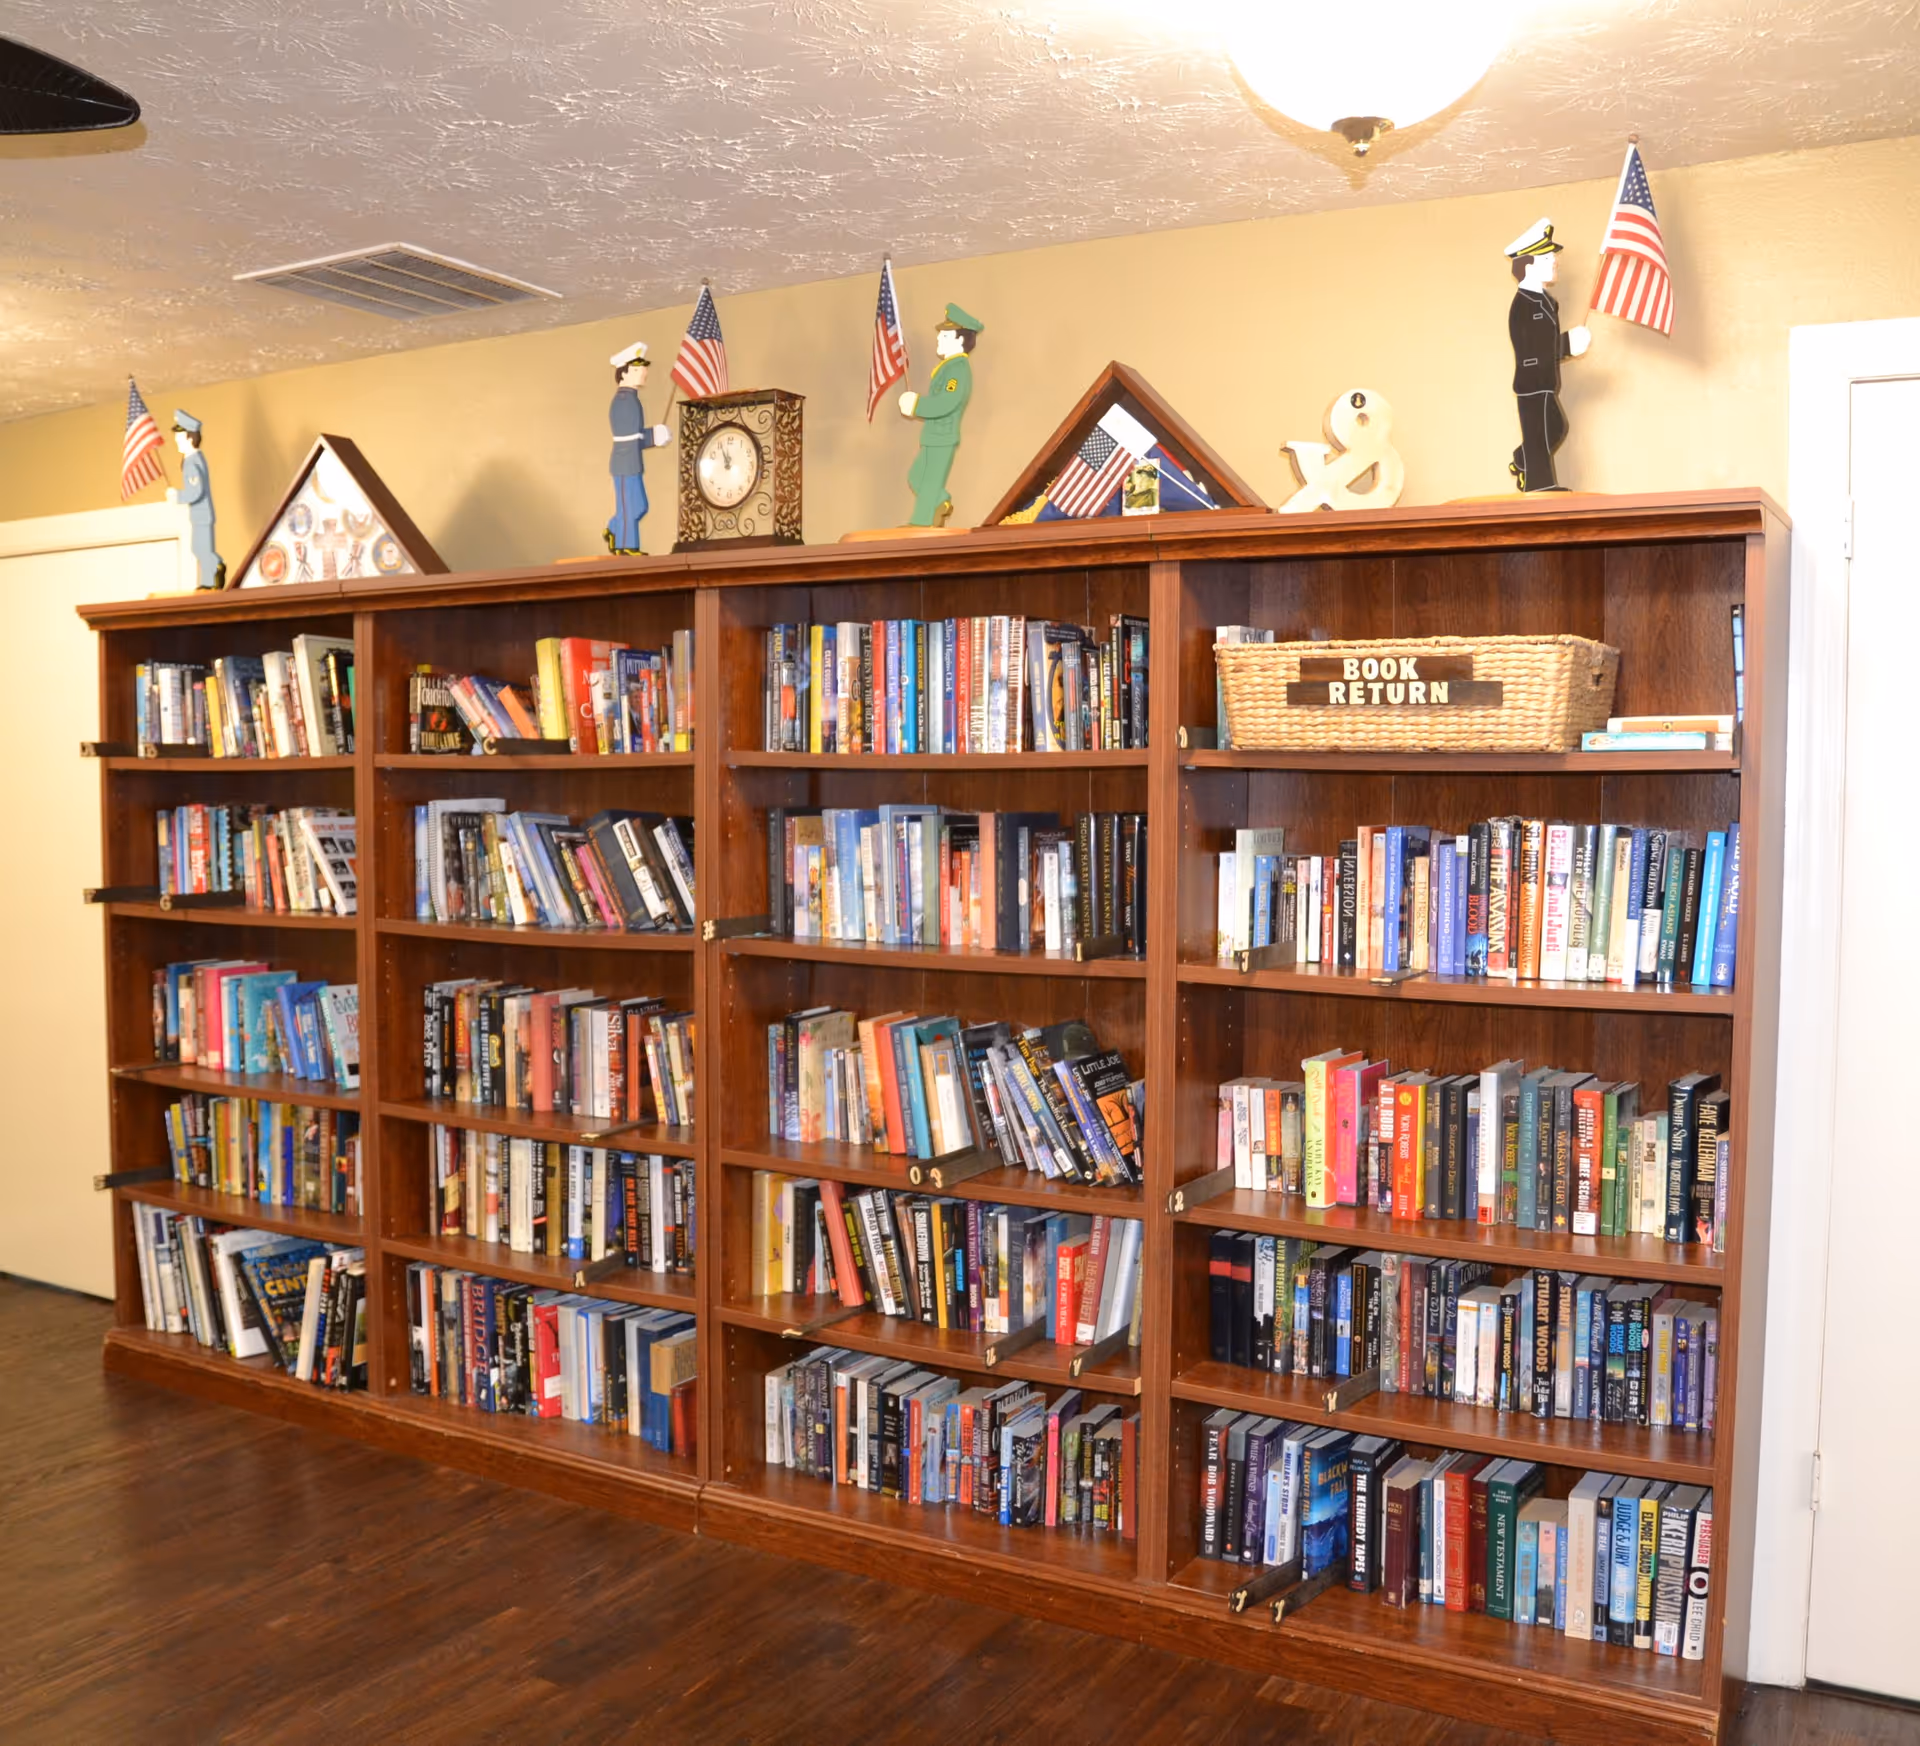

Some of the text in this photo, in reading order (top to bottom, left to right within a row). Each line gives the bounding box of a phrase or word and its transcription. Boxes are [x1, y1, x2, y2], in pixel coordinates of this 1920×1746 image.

[945, 624, 954, 642] Mary
[864, 644, 872, 675] LISTEN
[1343, 657, 1419, 680] BOOK
[865, 676, 872, 687] TO
[945, 672, 953, 693] Clark
[1328, 681, 1449, 704] RETURN
[970, 704, 984, 738] TRACE
[1080, 817, 1088, 852] THOMAS
[1103, 818, 1111, 852] THOMAS
[1480, 833, 1488, 858] JAMES
[1575, 847, 1583, 874] KERR
[1583, 844, 1592, 878] PHILIP
[1488, 857, 1507, 953] THE ASSASSINS
[1646, 862, 1659, 909] COLLECTION
[1665, 854, 1681, 935] CRAZY RICH ASIANS
[1684, 850, 1697, 922] FIFTY SHADES DARKER
[1468, 894, 1479, 935] BLOOD
[1570, 880, 1587, 948] METROPOLIS
[1667, 940, 1675, 960] KEVIN
[1680, 943, 1688, 962] JAMES
[424, 1014, 433, 1039] Back
[607, 1014, 622, 1050] Silva
[1018, 1038, 1029, 1056] Tim
[1036, 1079, 1048, 1093] The
[1045, 1093, 1063, 1120] Mindful
[1058, 1120, 1076, 1150] Moment
[1380, 1084, 1393, 1138] J. D. ROBB
[1541, 1101, 1550, 1158] DAN RATHER
[1398, 1114, 1410, 1159] NORA ROBERTS
[1449, 1124, 1457, 1160] SHADOWS
[1506, 1122, 1518, 1169] NORA ROBERTS
[1696, 1104, 1718, 1182] FAYE KELLERMAN
[1448, 1161, 1455, 1169] IN
[1555, 1130, 1567, 1206] WARSAW FURY
[1579, 1154, 1590, 1178] THREE
[626, 1178, 637, 1252] AN AIR THAT KILLS
[865, 1208, 883, 1256] BRAD THOR
[968, 1203, 976, 1235] ADRIANA
[676, 1228, 684, 1258] FALLEN
[915, 1212, 929, 1262] SHAKEDOWN
[1276, 1240, 1286, 1301] DAVID ROSENFELT
[1080, 1260, 1097, 1323] THE FIRE THEFT
[1559, 1286, 1570, 1326] STUART
[472, 1284, 487, 1375] BRIDGE
[1536, 1275, 1549, 1372] STUART WOODS
[1593, 1304, 1602, 1321] Rock
[1503, 1315, 1512, 1369] STUART WOODS
[1592, 1322, 1602, 1352] Orchard
[1616, 1324, 1624, 1354] STUART
[1628, 1322, 1636, 1351] WOODS
[1629, 1380, 1639, 1415] DIRT
[1209, 1430, 1218, 1460] FEAR
[1281, 1452, 1292, 1515] MULLAH'S STORM
[1303, 1451, 1312, 1497] BLACKWATER
[1205, 1465, 1217, 1541] BOB WOODWARD
[1355, 1474, 1366, 1572] THE KENNEDY TAPES
[1662, 1511, 1689, 1520] PHILIP
[1615, 1501, 1632, 1567] JUDGE & JURY
[1639, 1511, 1654, 1575] ELMORE LEONARD
[1660, 1518, 1687, 1554] KERR
[1697, 1519, 1712, 1565] PERSUADER
[1496, 1513, 1506, 1600] NEW TESTAMENT
[1596, 1522, 1608, 1600] THE REAL CARTER
[1655, 1555, 1684, 1623] PRUSSIAN
[1690, 1601, 1701, 1642] LEE CHILD
